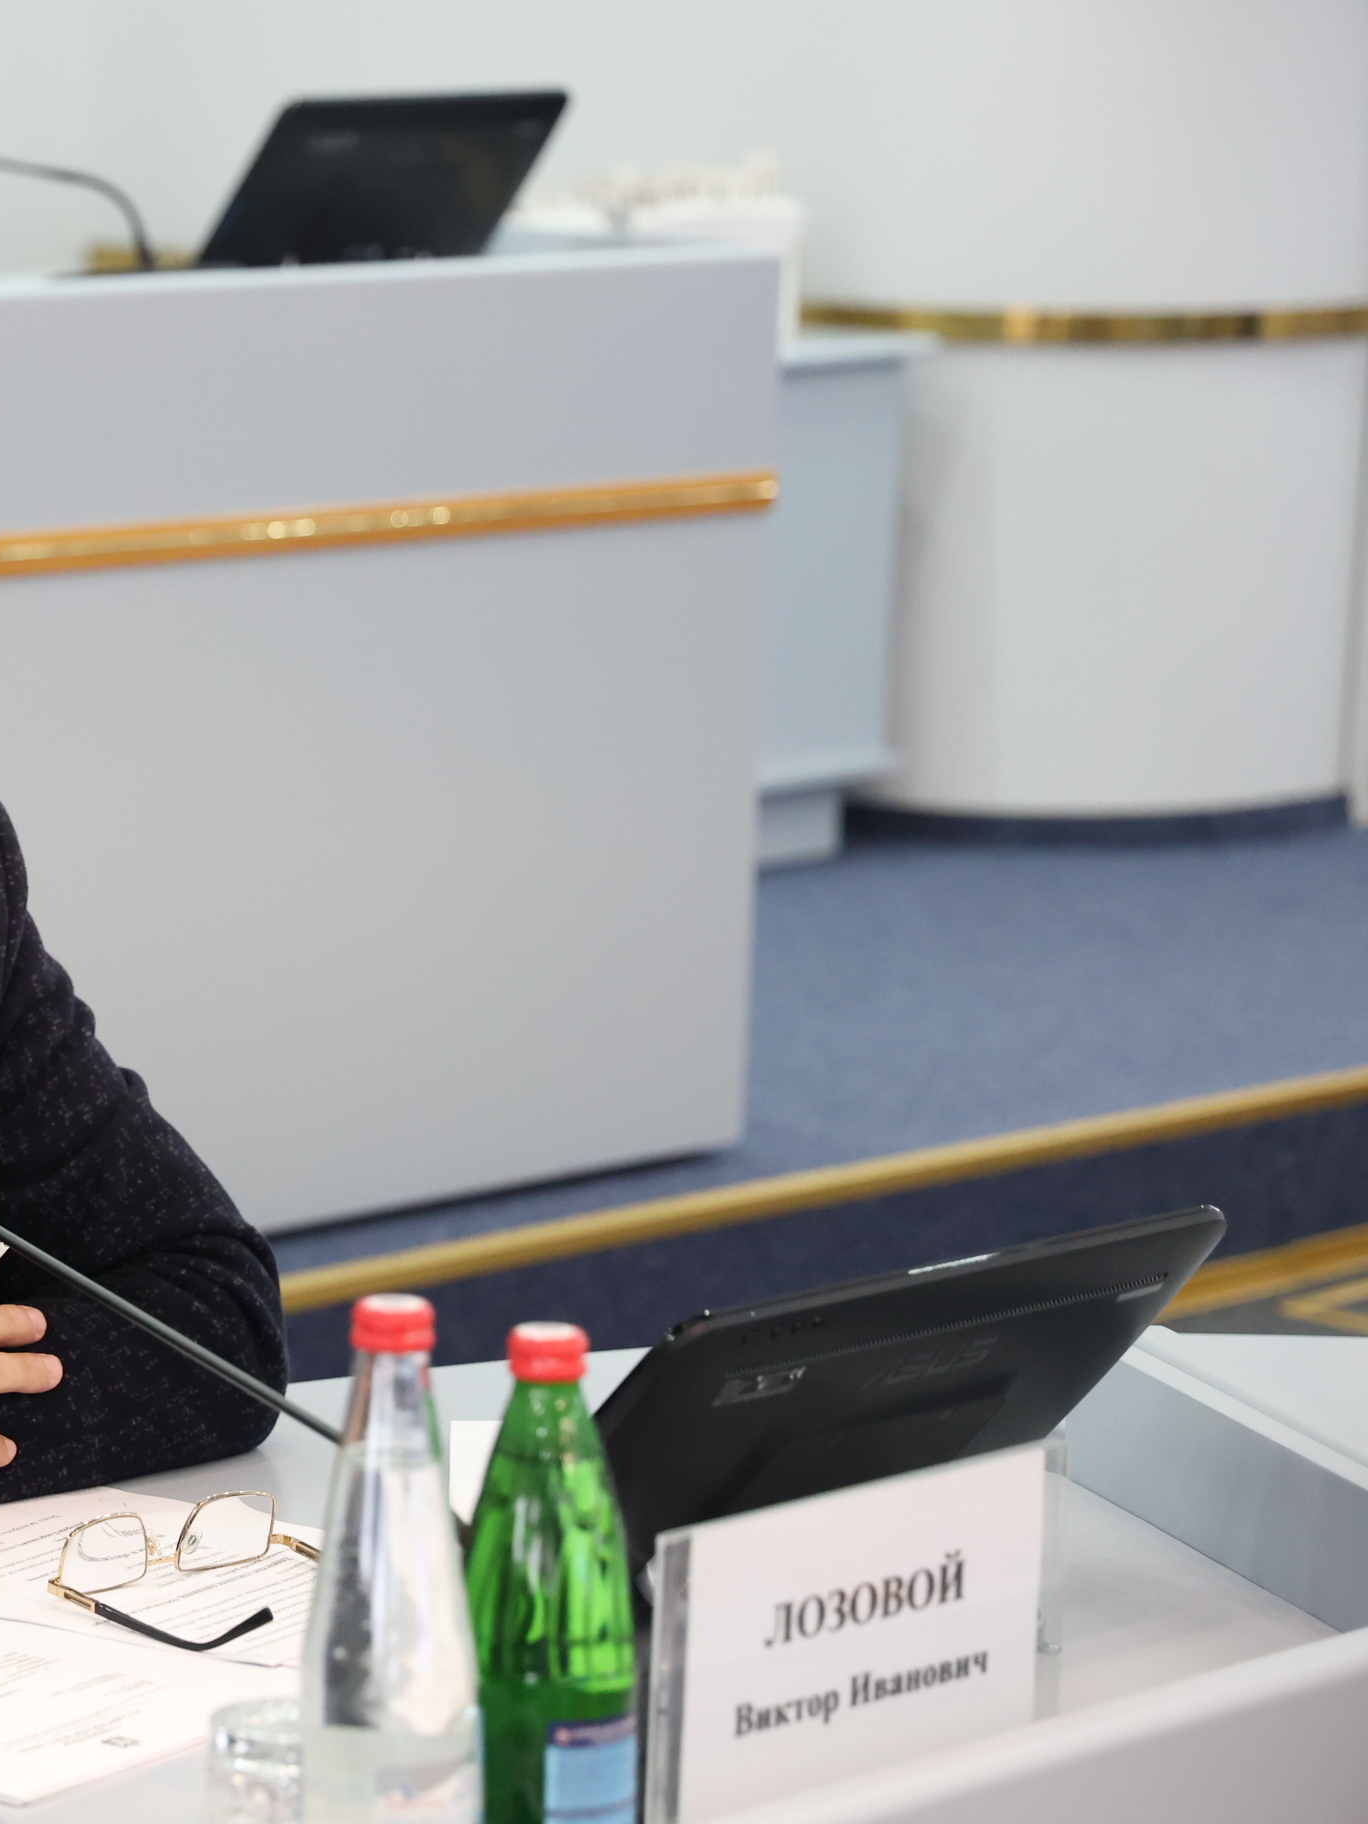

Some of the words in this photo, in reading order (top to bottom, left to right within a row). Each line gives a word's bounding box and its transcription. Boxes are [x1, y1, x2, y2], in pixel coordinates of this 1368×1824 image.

[763, 1549, 967, 1649] ЛОЗОВОЙ
[733, 1688, 840, 1739] Виктор
[849, 1650, 989, 1707] Иванович
